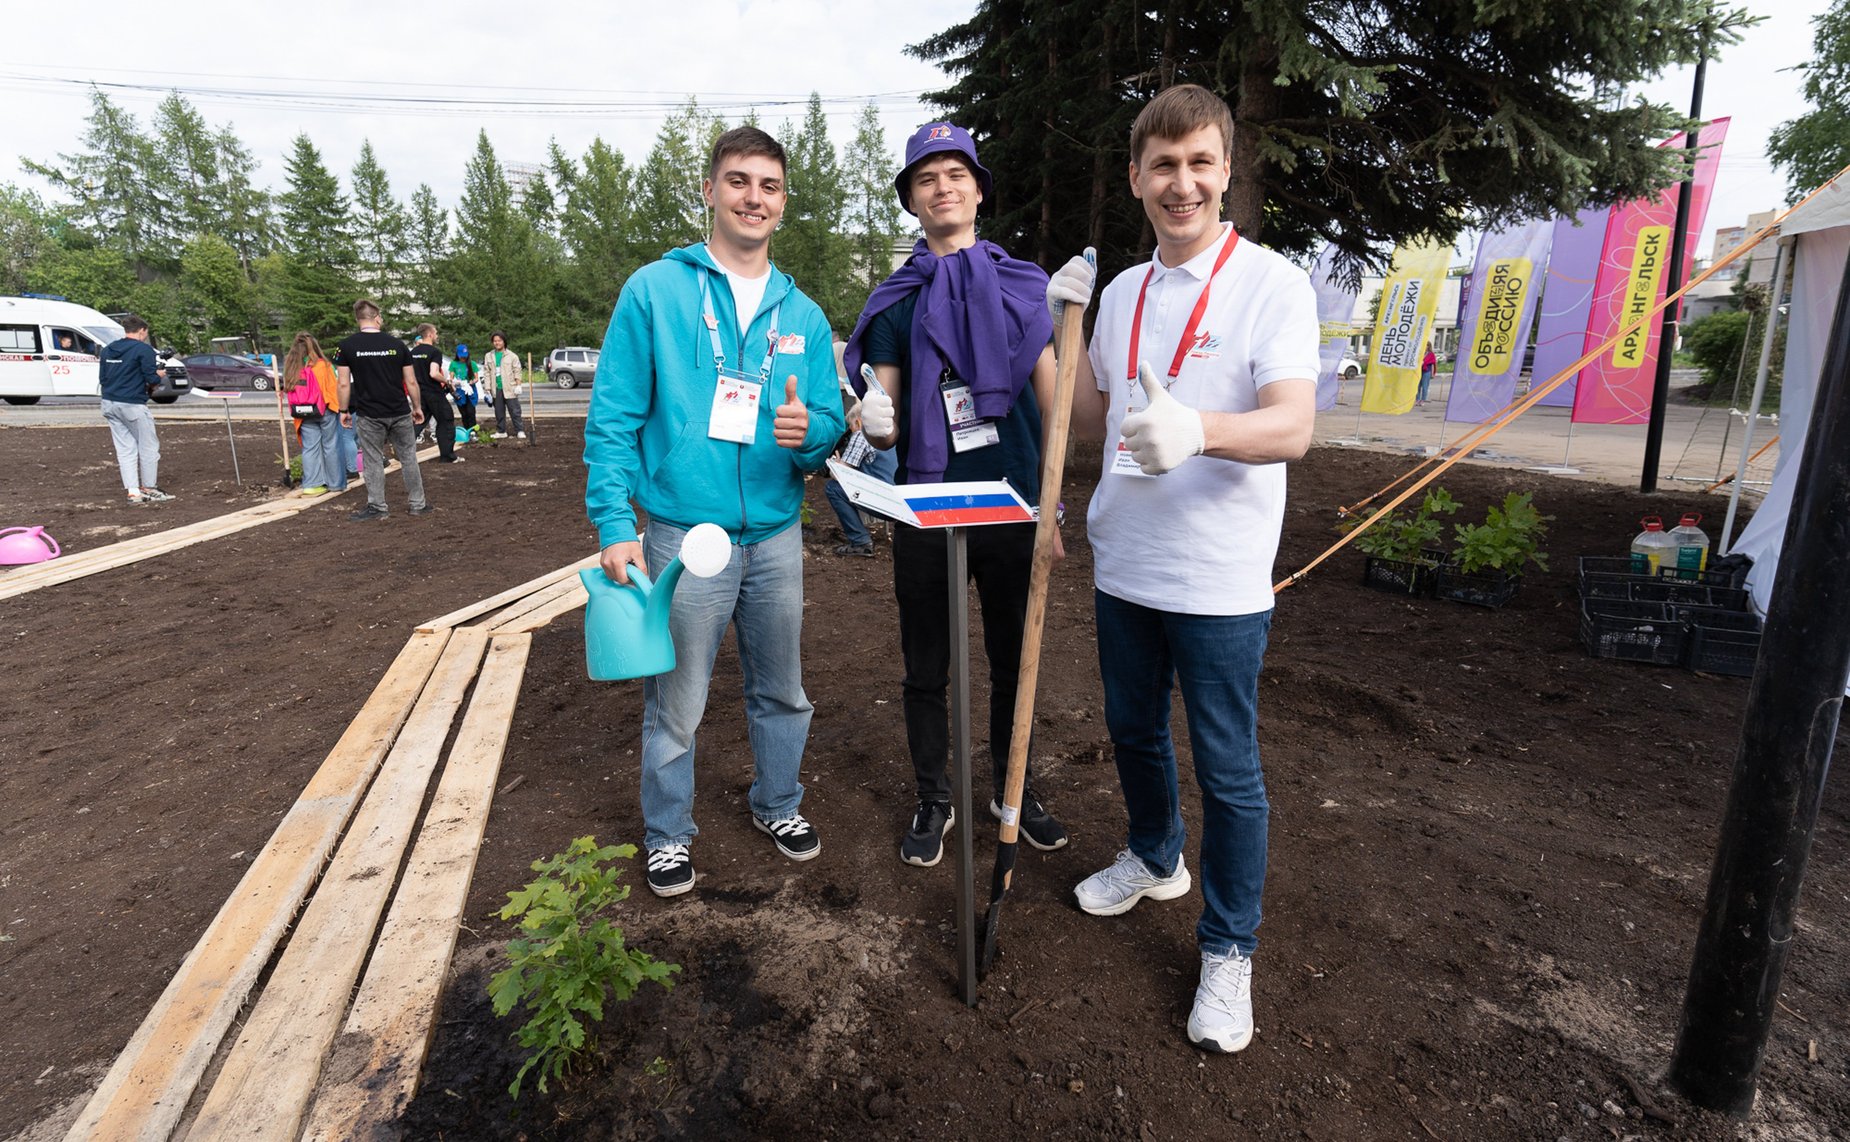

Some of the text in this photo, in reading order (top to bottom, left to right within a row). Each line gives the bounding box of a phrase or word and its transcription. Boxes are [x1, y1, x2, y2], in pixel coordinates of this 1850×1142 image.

[1380, 327, 1397, 365] ДЕНЬ
[1392, 280, 1420, 366] МОЛОДЁЖИ
[1475, 264, 1510, 369] ОБЪЕДИНЯЯ
[1494, 278, 1522, 355] РОССИЮ
[52, 365, 70, 375] 25
